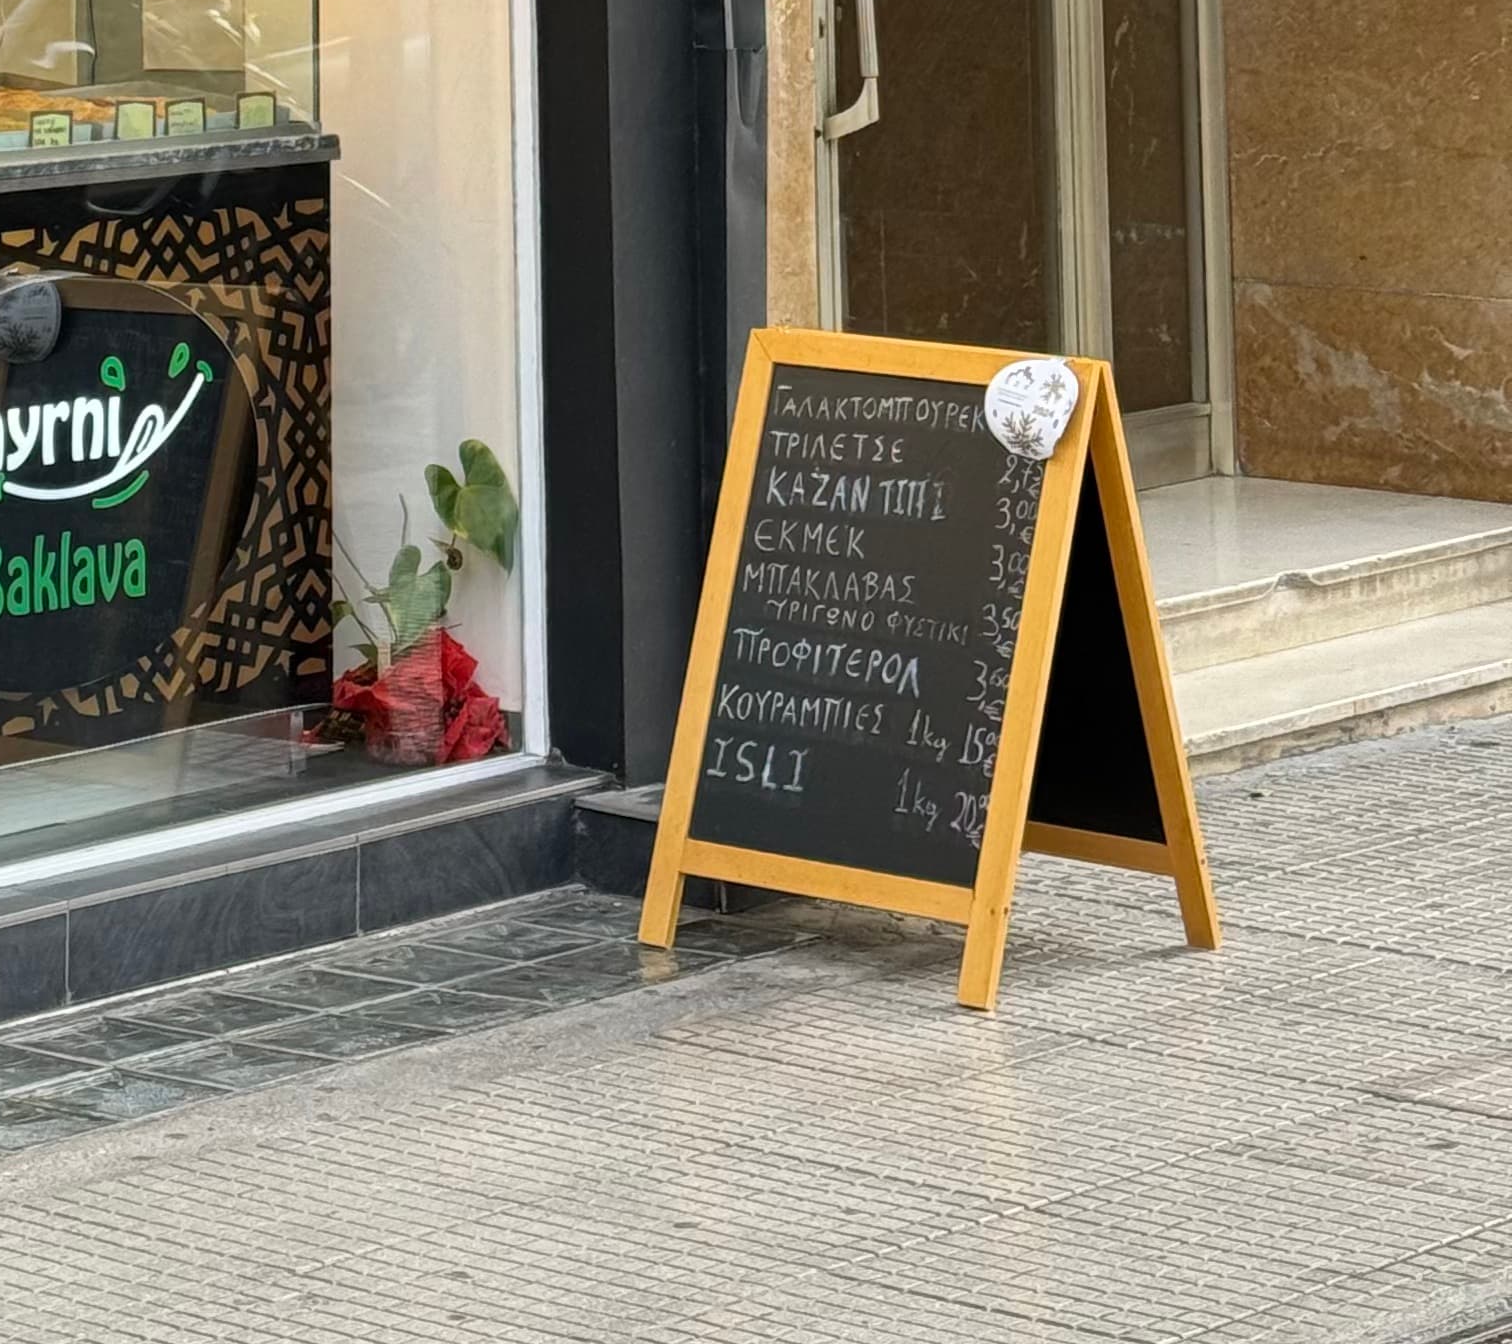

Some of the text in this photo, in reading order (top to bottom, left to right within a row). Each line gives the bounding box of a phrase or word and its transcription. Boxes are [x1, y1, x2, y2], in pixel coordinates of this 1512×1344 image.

[773, 385, 986, 432] ΓΑΛΑΚΤΟΜΠΟΥΡΕΚ
[768, 430, 904, 463] ΤΡΙΛΕΤΣΕ
[754, 518, 865, 559] ΕΚΜΕΚ
[742, 563, 916, 605] ΜΠΑΚΛΑΒΑΣ
[886, 611, 969, 646] ΦΥΣΤΙΚΙ
[733, 628, 921, 699] ΠΡΟΦΙΤΕΡΟΛ
[717, 684, 885, 735] ΚΟΥΡΑΜΠΙΕΣ
